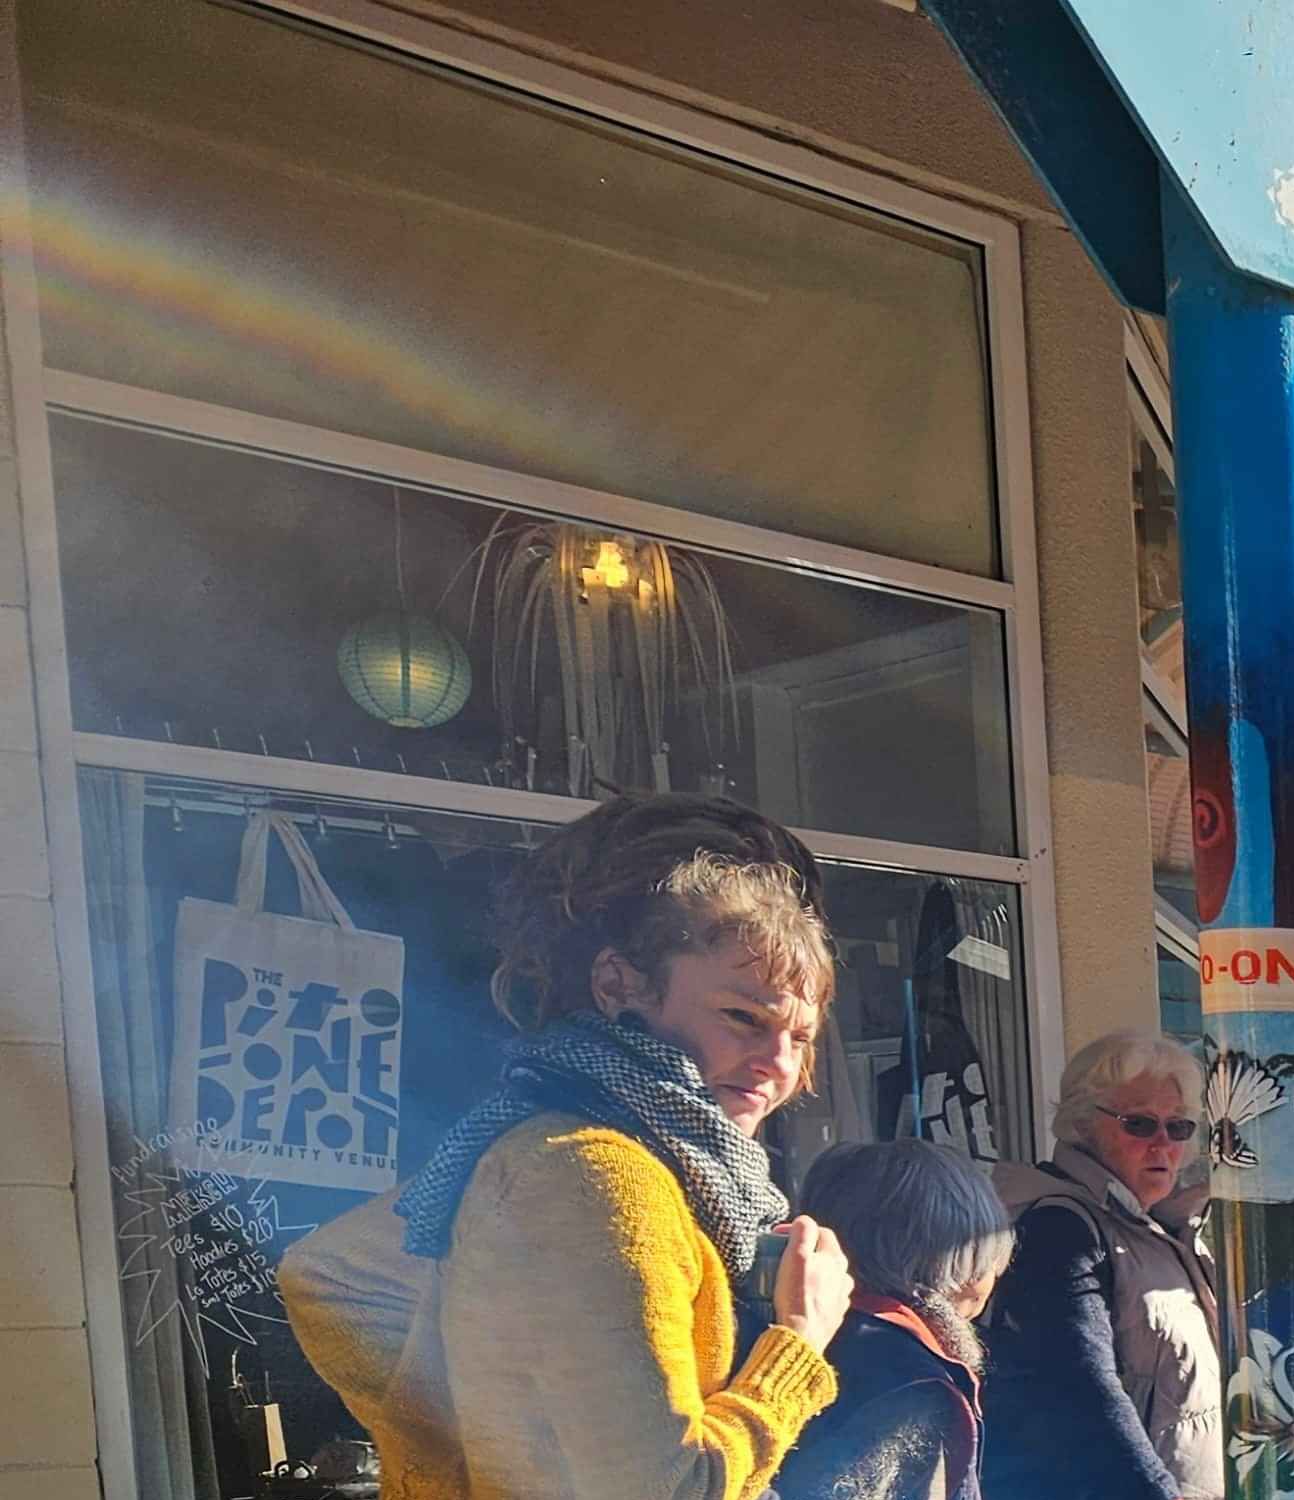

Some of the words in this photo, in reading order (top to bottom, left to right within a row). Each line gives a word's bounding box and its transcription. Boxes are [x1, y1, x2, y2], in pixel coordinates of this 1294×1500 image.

[253, 967, 282, 987] THE
[160, 1233, 205, 1258] Tees
[210, 1203, 244, 1233] $10
[190, 1238, 240, 1271] Hoodies
[241, 1216, 273, 1247] $20
[200, 1267, 238, 1290] Totes
[238, 1249, 268, 1278] $15
